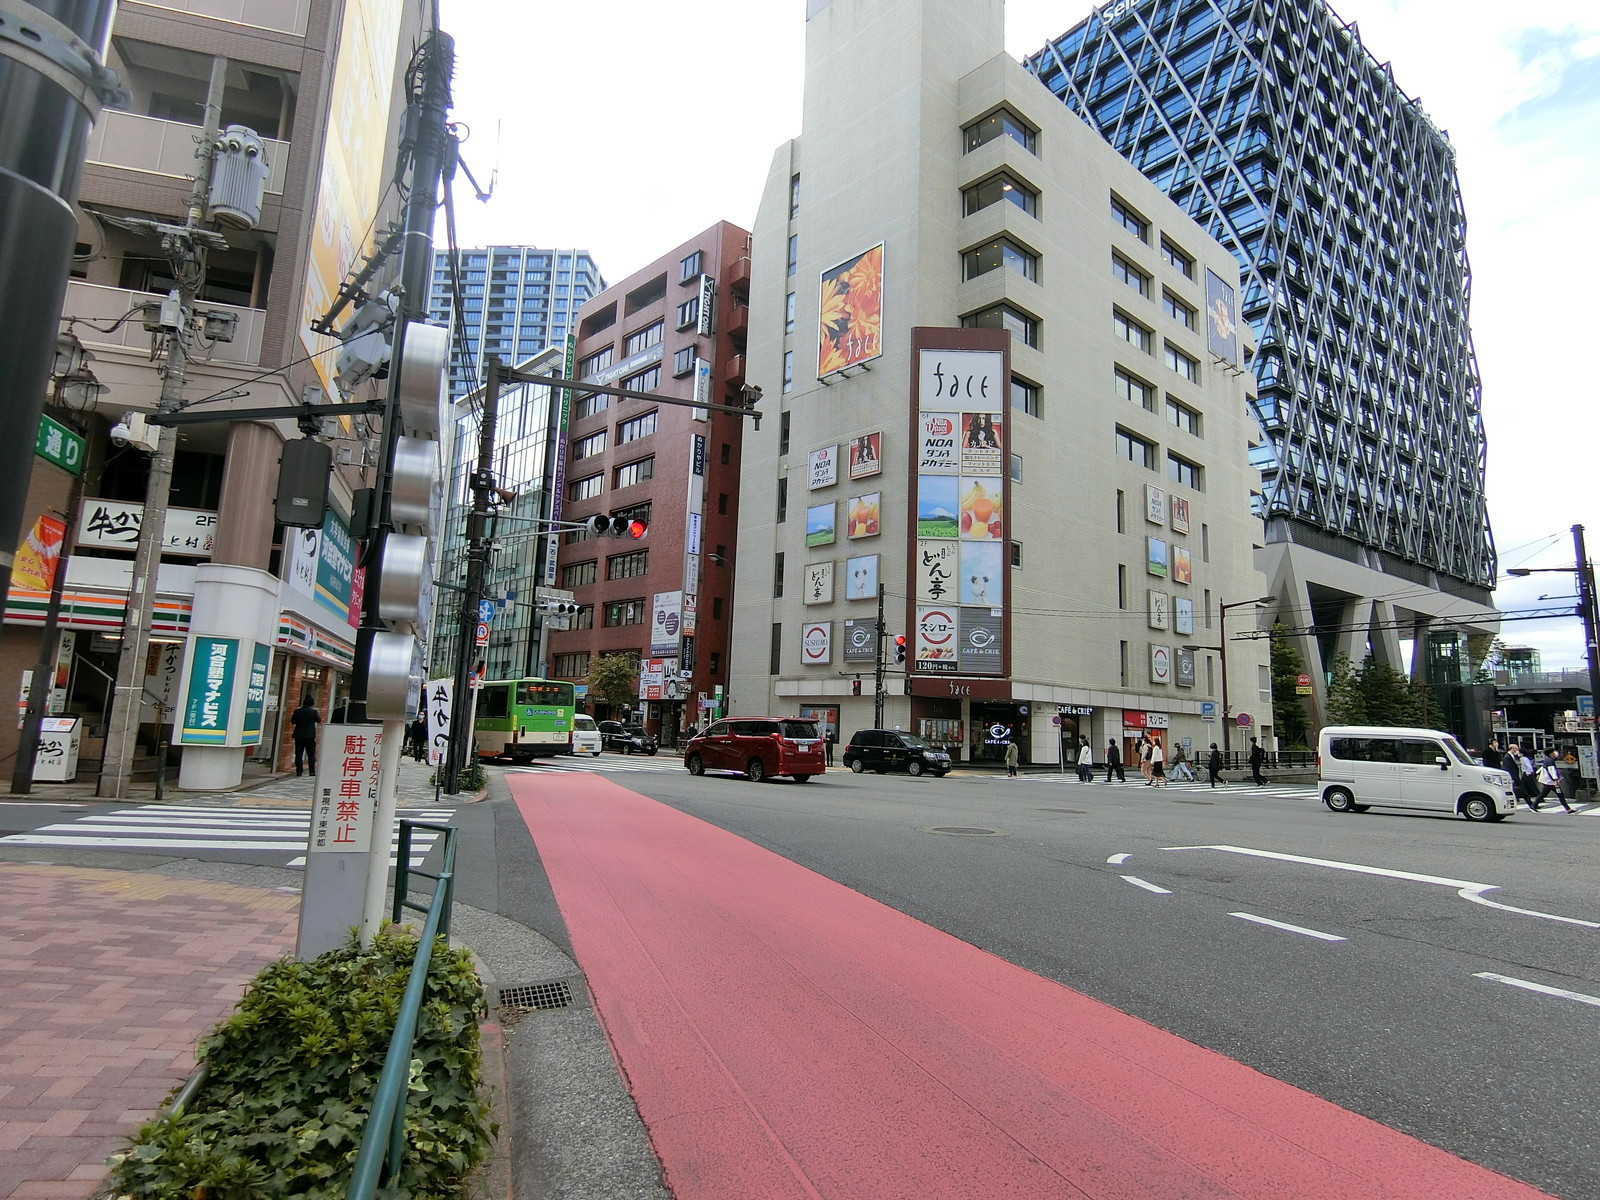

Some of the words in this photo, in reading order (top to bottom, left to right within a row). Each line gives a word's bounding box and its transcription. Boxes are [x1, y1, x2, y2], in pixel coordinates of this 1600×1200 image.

[933, 361, 989, 399] face
[925, 439, 954, 448] NOA
[926, 449, 950, 458] ダンス
[814, 459, 831, 471] NOA
[920, 459, 958, 468] アカデミー
[195, 515, 217, 527] 2F
[922, 550, 952, 600] どん亭
[919, 623, 955, 632] スシロー
[200, 643, 229, 728] 河合塾マナビス
[949, 681, 971, 696] face
[1148, 715, 1168, 726] スシロー
[333, 735, 368, 843] 駐停車禁止
[316, 787, 332, 848] 警視庁・東京都
